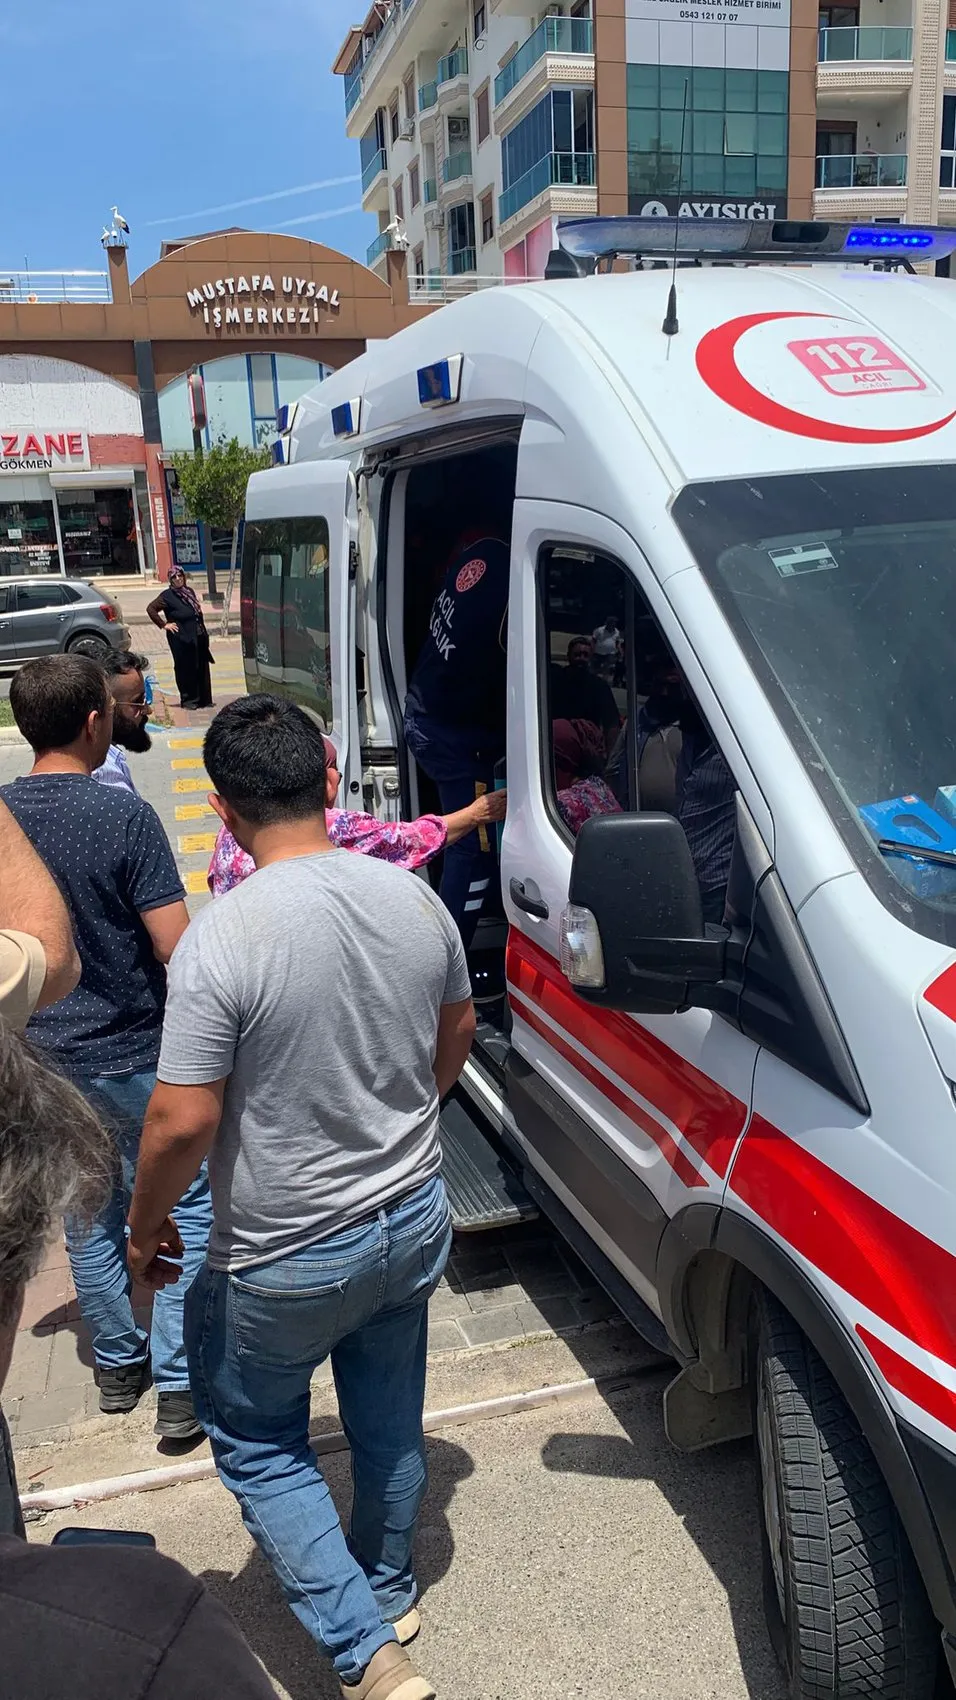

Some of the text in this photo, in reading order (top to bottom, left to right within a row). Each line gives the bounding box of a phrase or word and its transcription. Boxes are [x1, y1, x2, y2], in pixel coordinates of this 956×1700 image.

[680, 10, 699, 19] 0543
[701, 12, 714, 20] 121
[186, 274, 340, 308] MUSTAFA UYSAL
[203, 302, 319, 328] İŞMERKEZİ
[806, 342, 893, 371] 112
[0, 431, 84, 457] ZANE
[0, 458, 52, 470] GÖKMEN
